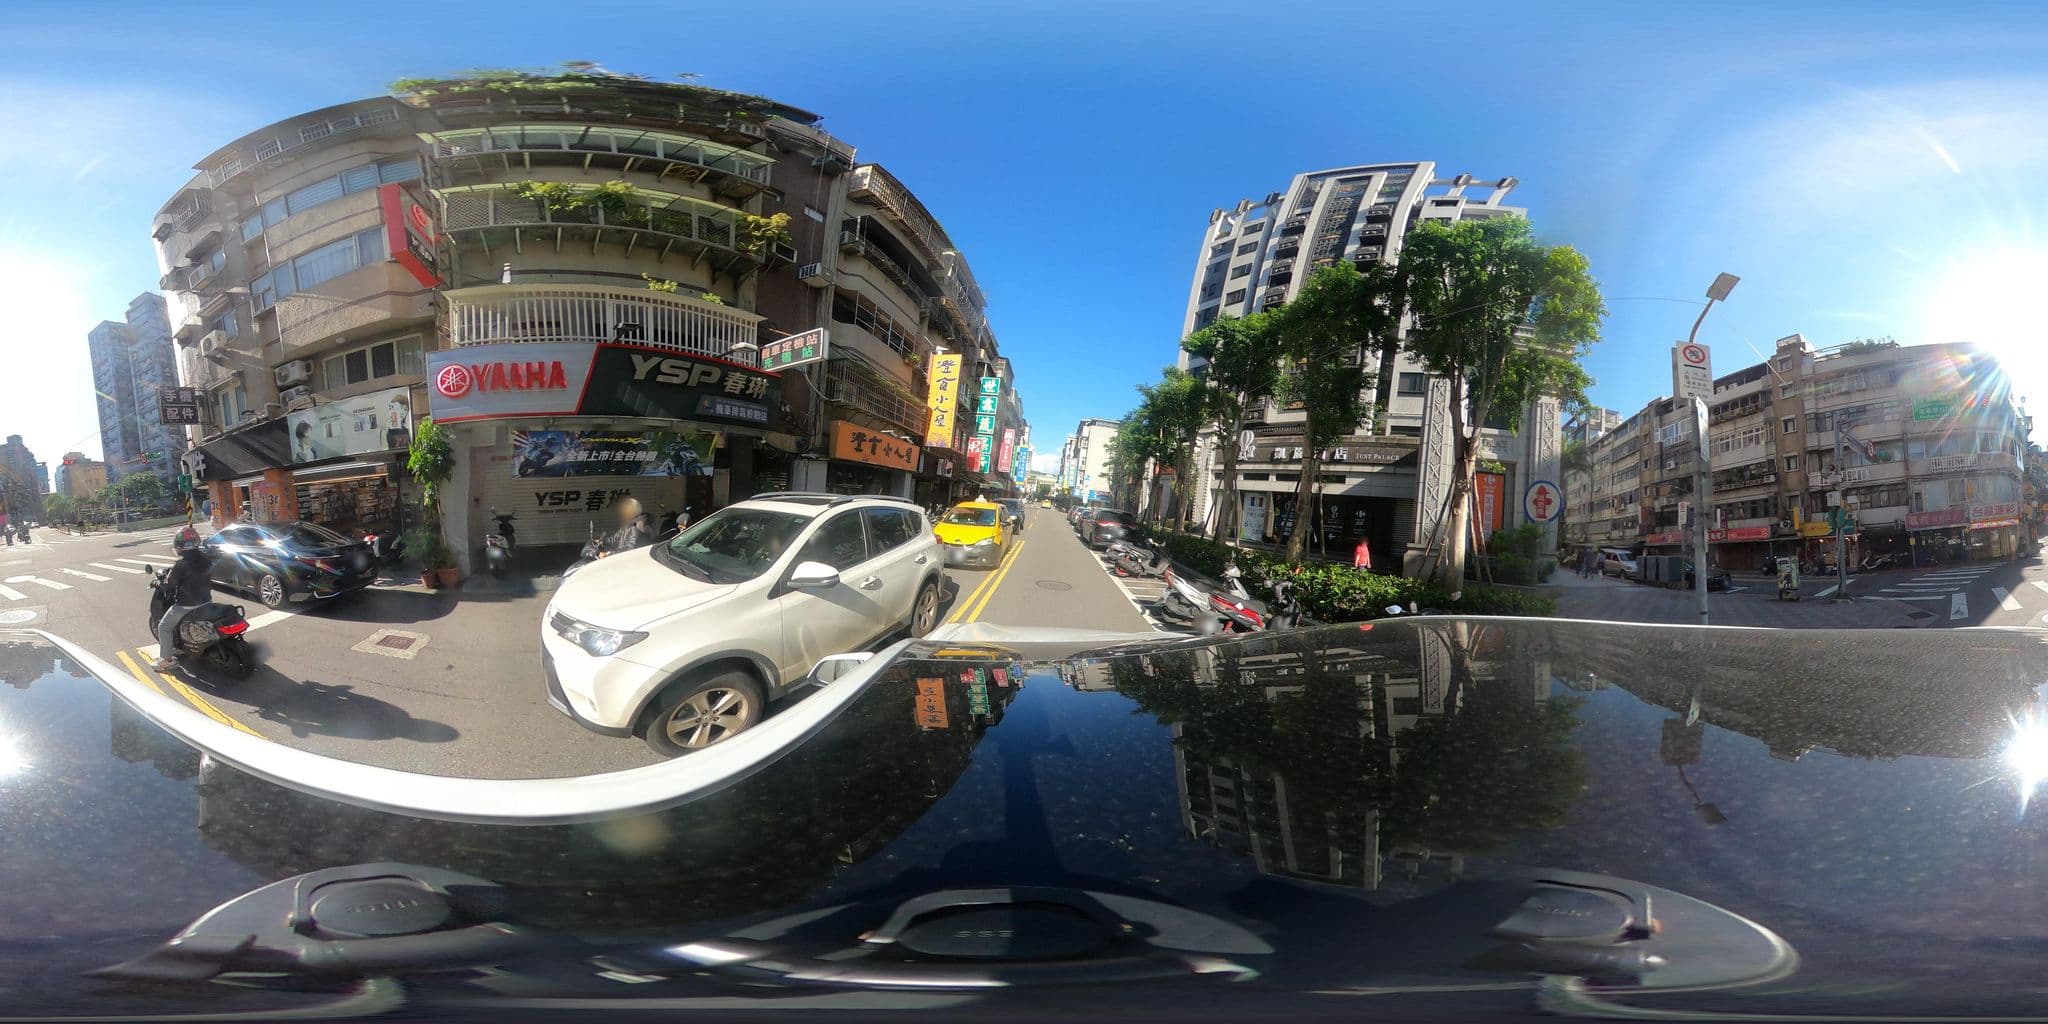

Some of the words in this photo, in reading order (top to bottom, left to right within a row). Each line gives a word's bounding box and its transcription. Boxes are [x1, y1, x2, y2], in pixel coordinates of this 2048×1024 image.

[630, 353, 722, 388] YSP
[723, 371, 770, 400] 春琳
[165, 407, 195, 420] 配件
[534, 490, 581, 507] YSP
